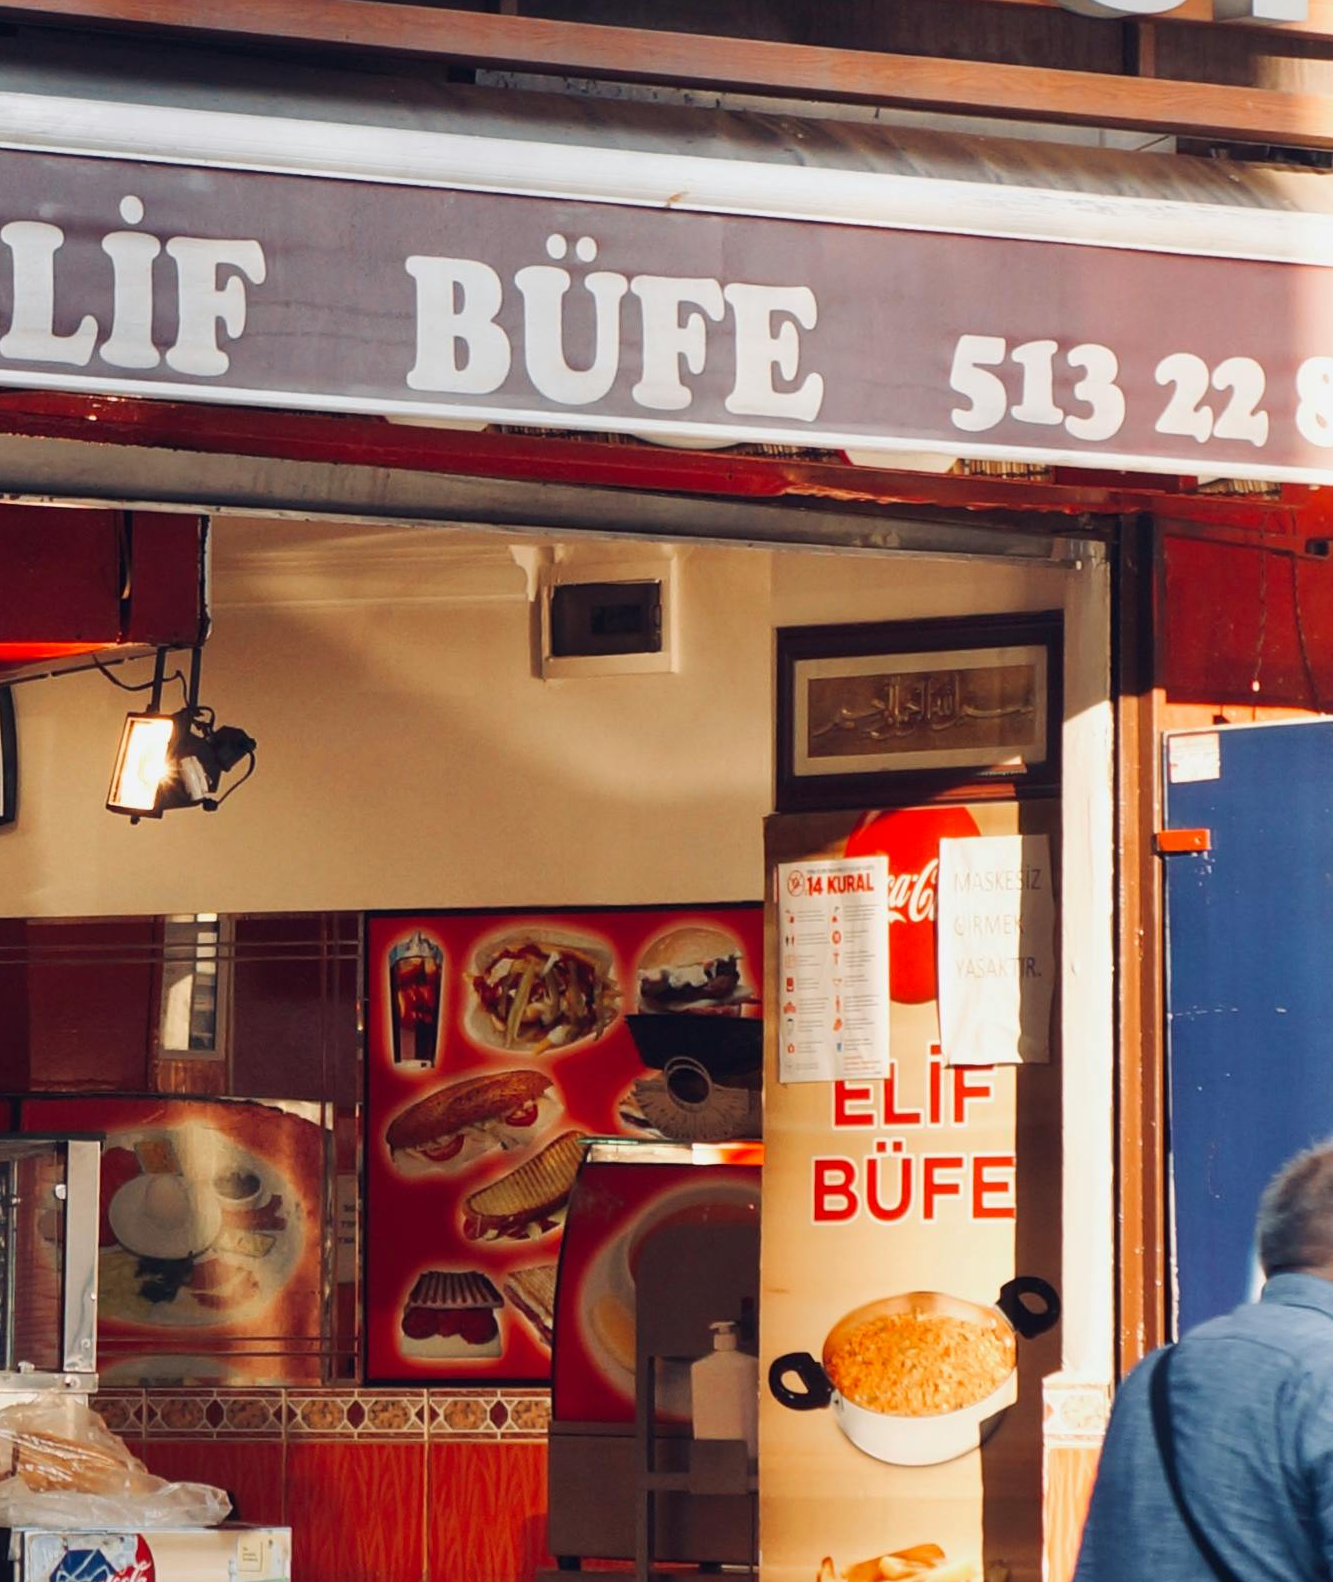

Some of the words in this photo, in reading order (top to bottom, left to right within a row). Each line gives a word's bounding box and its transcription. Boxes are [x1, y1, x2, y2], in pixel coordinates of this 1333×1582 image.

[405, 233, 825, 422] BÜFE
[950, 334, 1126, 442] 513
[1155, 353, 1269, 448] 22
[807, 876, 823, 896] 14
[827, 872, 875, 895] KURAL
[834, 1044, 993, 1127] ELİF
[813, 1141, 1016, 1223] BÜFE
